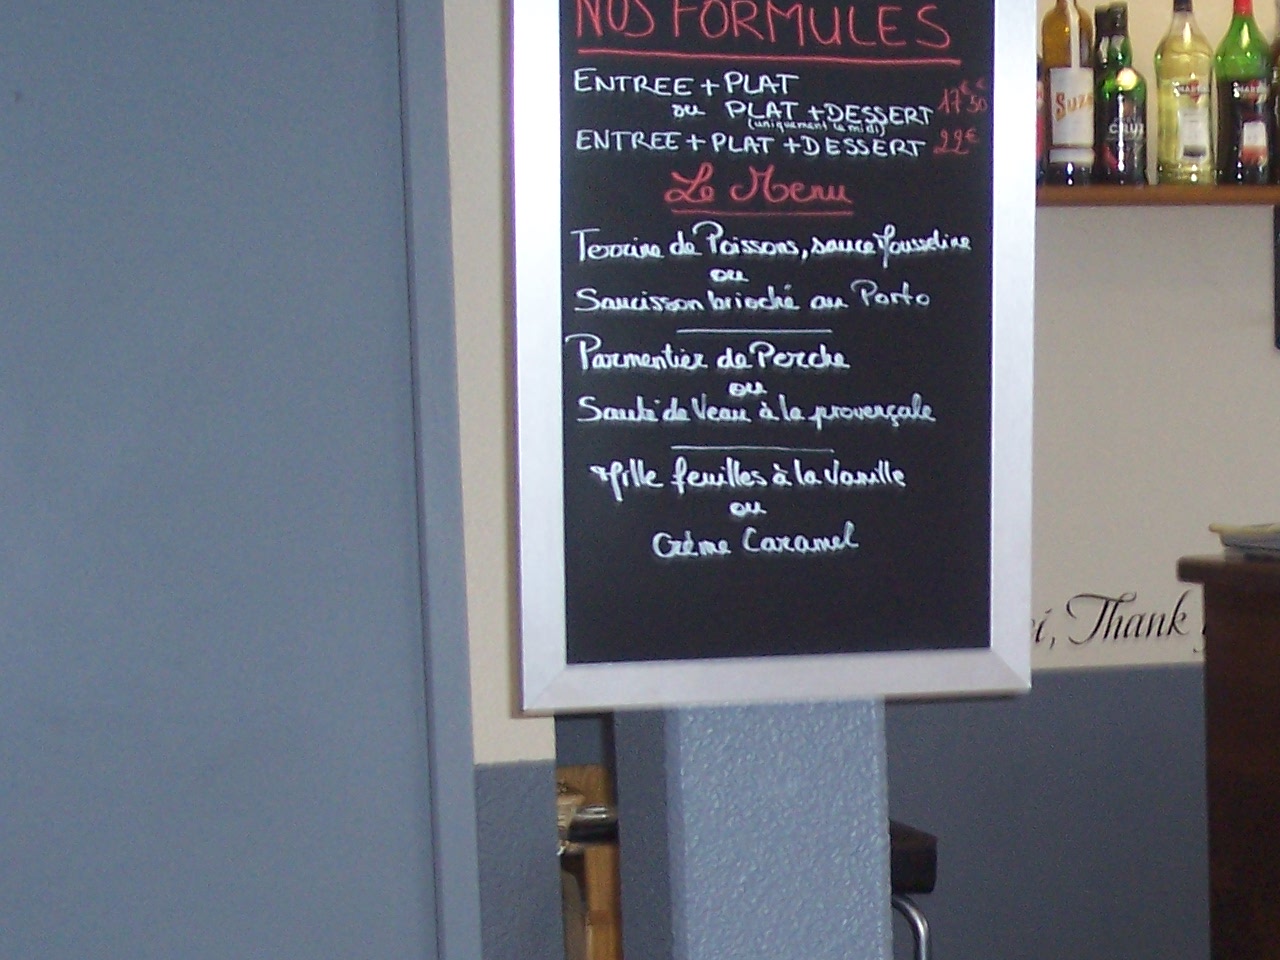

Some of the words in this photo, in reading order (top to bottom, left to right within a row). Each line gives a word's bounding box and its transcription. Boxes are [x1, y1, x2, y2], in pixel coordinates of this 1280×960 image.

[575, 0, 656, 38] NOS
[673, 0, 951, 48] FORMULES
[573, 68, 694, 96] ENTREE
[723, 71, 800, 95] PLAT
[724, 101, 799, 122] PLAT
[576, 129, 682, 150] ENTREE
[711, 132, 775, 154] PLAT
[663, 161, 716, 202] Le
[730, 164, 853, 204] Menu
[570, 228, 666, 261] Terrine
[669, 230, 700, 258] de
[810, 236, 878, 256] sauce
[709, 268, 749, 284] ou
[573, 288, 706, 313] Saucisson
[707, 283, 801, 312] brioché
[809, 292, 849, 310] au
[850, 279, 932, 308] Porto
[564, 333, 708, 371] Parmentier
[716, 343, 753, 371] de
[748, 340, 851, 370] Perche
[728, 382, 768, 397] ou
[576, 396, 661, 423] Sauté
[661, 397, 689, 423] de
[691, 393, 752, 423] Veau
[758, 400, 779, 421] à
[779, 394, 806, 422] la
[809, 393, 937, 431] provençale
[670, 457, 768, 495] feuilles
[771, 464, 792, 487] à
[794, 459, 825, 487] la
[729, 501, 767, 517] ou
[651, 531, 732, 559] Crème
[741, 520, 860, 551] Caramel
[1066, 589, 1193, 645] Thank
